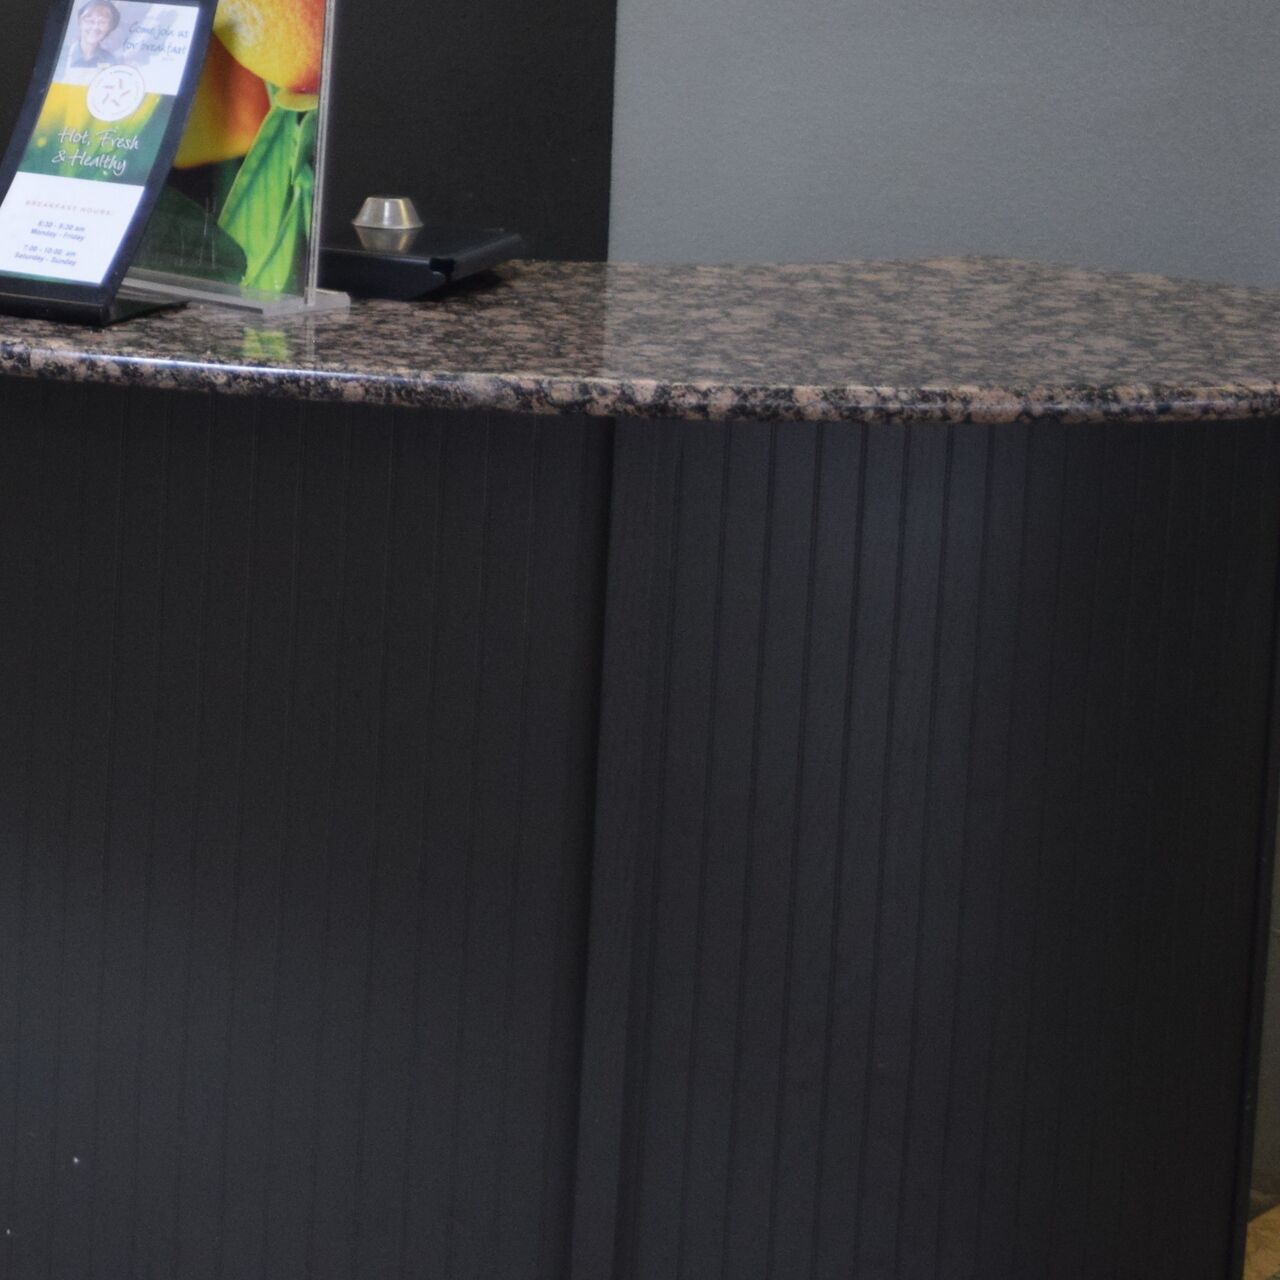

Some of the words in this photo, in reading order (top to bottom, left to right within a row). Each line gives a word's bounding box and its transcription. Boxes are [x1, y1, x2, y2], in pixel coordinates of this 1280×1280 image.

[58, 127, 90, 147] Hot,
[96, 128, 139, 150] Fresh
[51, 149, 65, 164] &
[69, 149, 126, 177] Healthy
